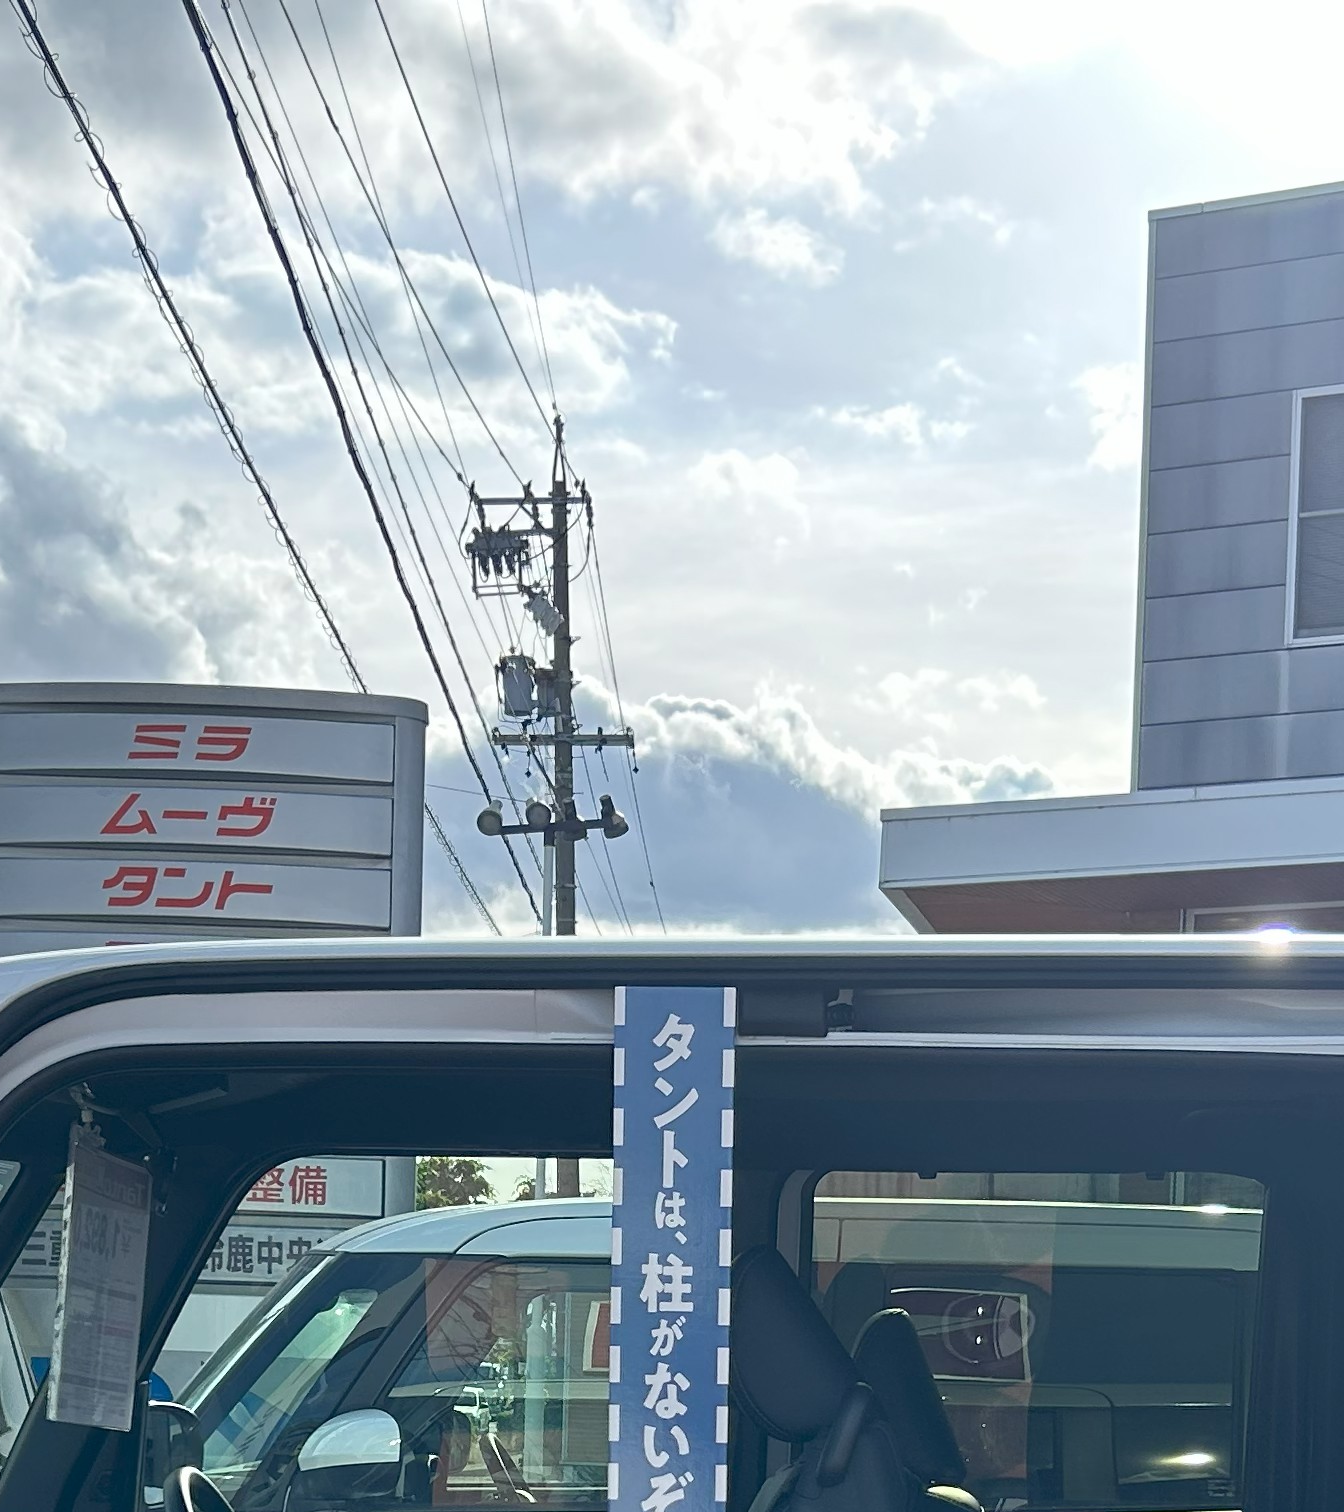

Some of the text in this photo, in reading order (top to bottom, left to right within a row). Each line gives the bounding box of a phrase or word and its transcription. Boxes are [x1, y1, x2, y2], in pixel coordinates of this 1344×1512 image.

[127, 723, 253, 762] ミラ
[99, 792, 278, 838] ムーヴ
[101, 865, 273, 911] タント
[246, 1165, 328, 1206] 整備
